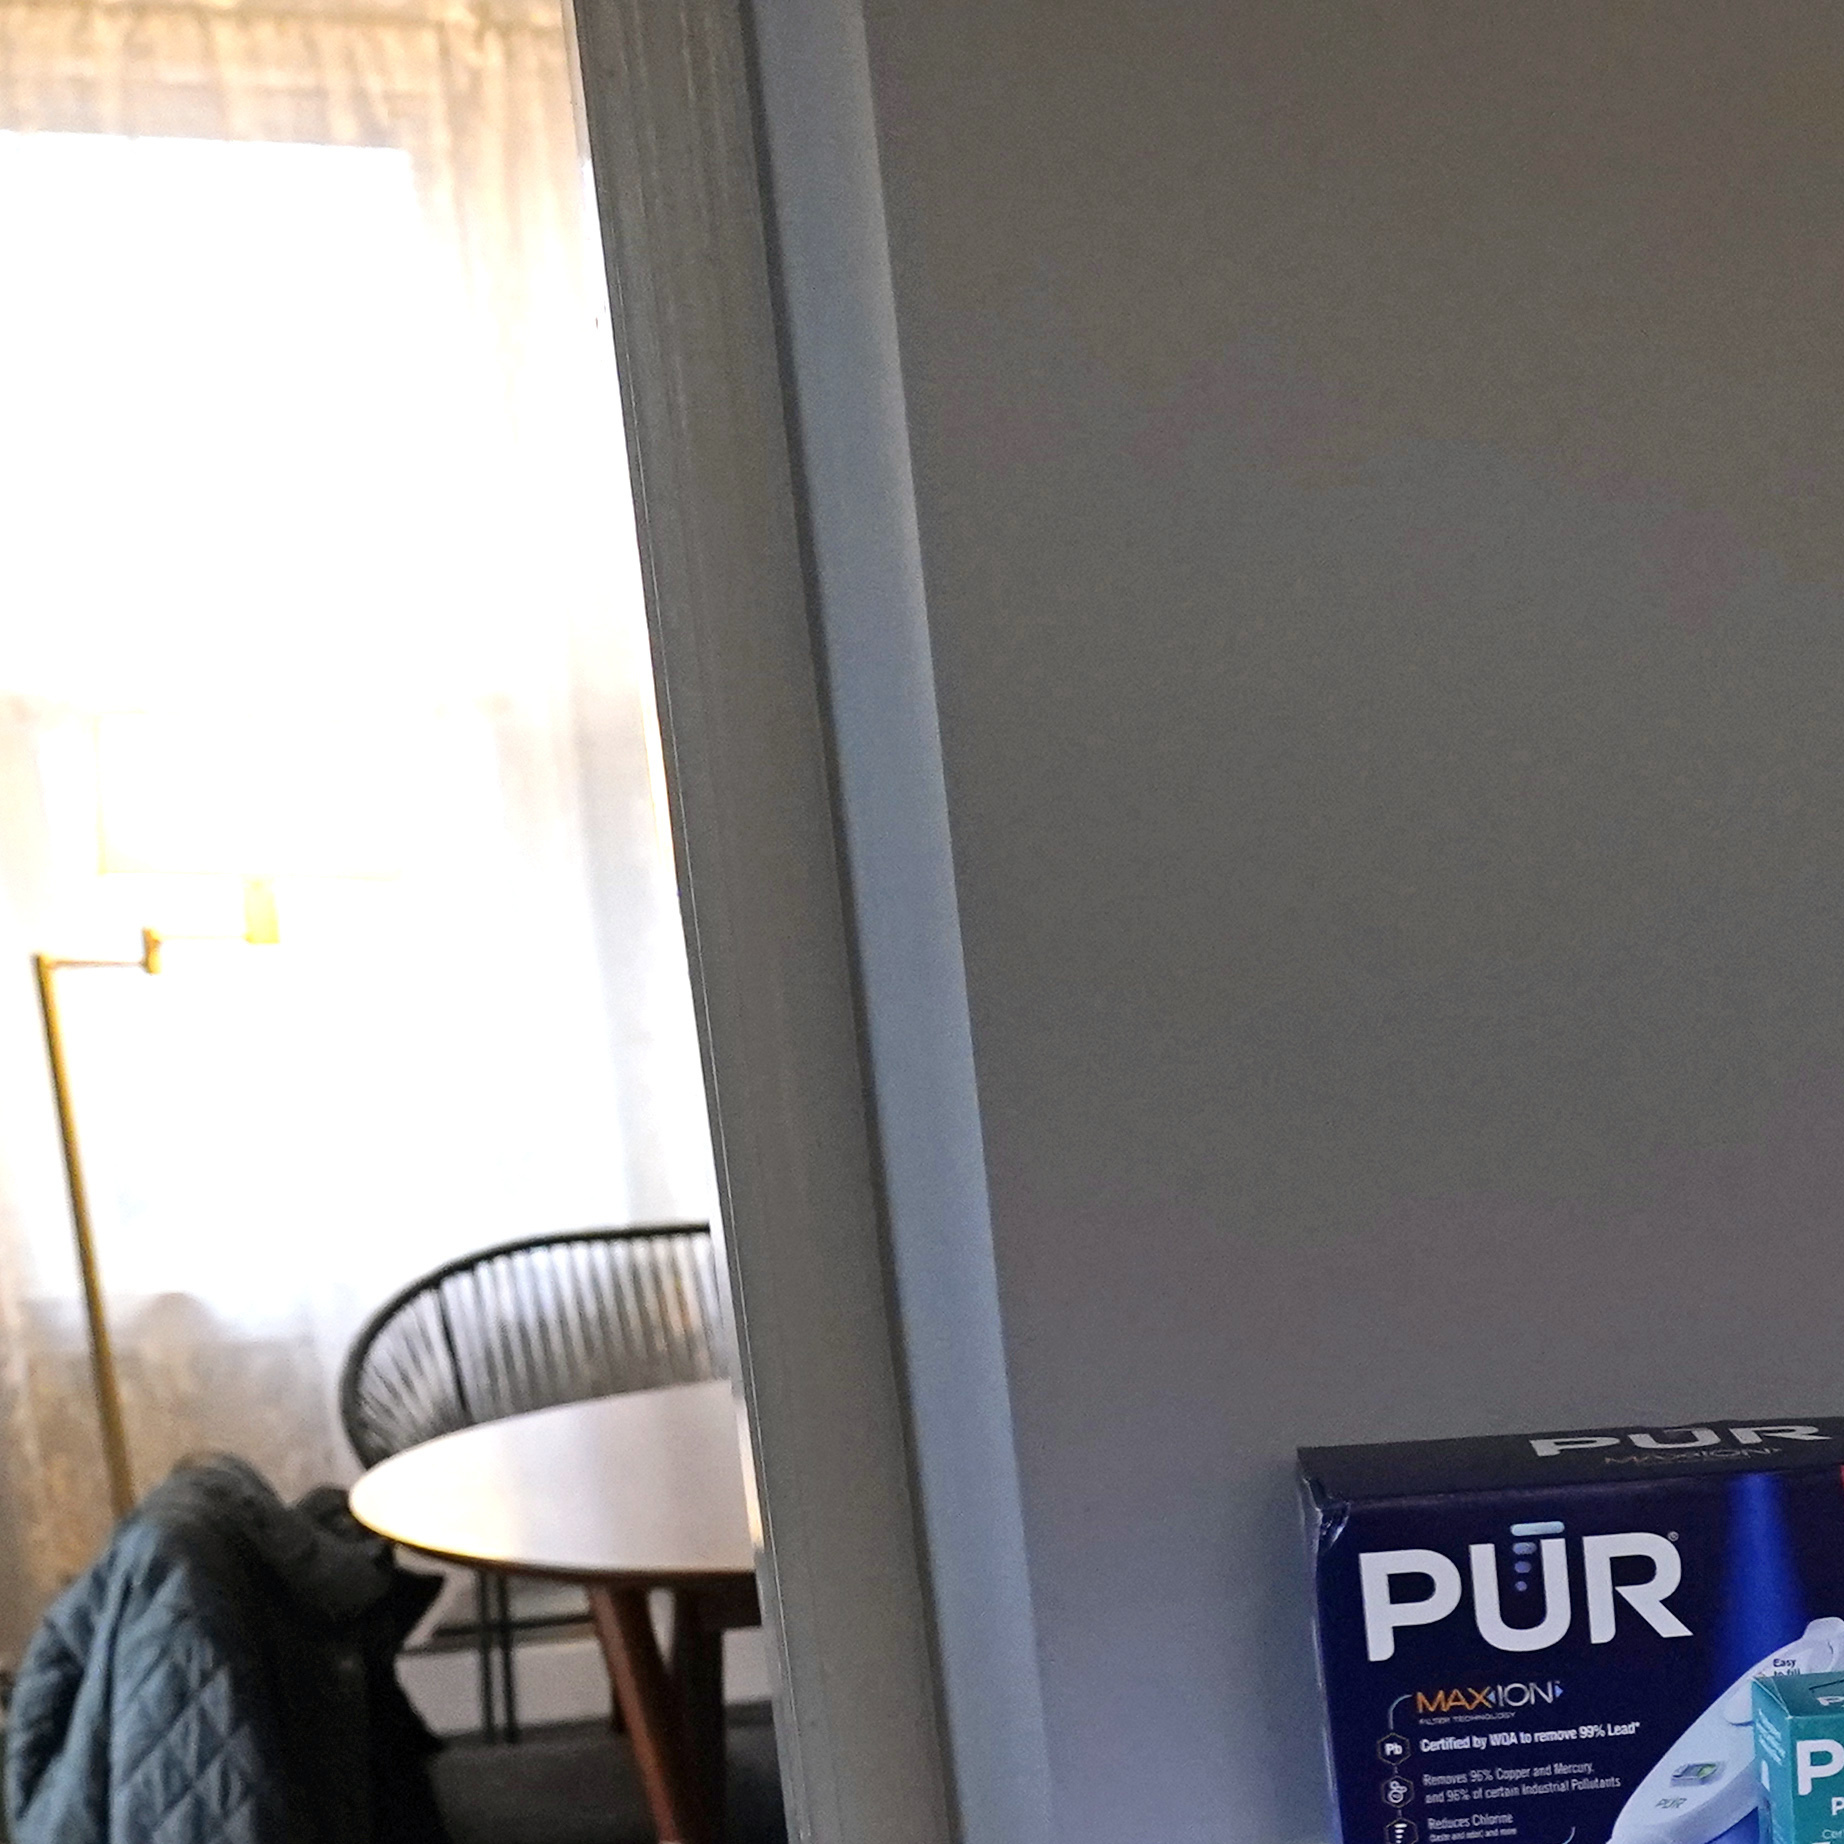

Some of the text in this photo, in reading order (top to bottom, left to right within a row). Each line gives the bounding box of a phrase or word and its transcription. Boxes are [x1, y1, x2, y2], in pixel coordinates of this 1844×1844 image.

[1773, 1658, 1797, 1670] Easy
[1421, 1736, 1471, 1752] Certified
[1472, 1735, 1487, 1750] by
[1520, 1732, 1532, 1744] to
[1534, 1729, 1577, 1743] remove
[1578, 1724, 1606, 1738] 99%
[1384, 1742, 1403, 1756] Pb
[1495, 1767, 1531, 1781] Copper
[1533, 1765, 1552, 1776] and
[1425, 1791, 1445, 1804] and
